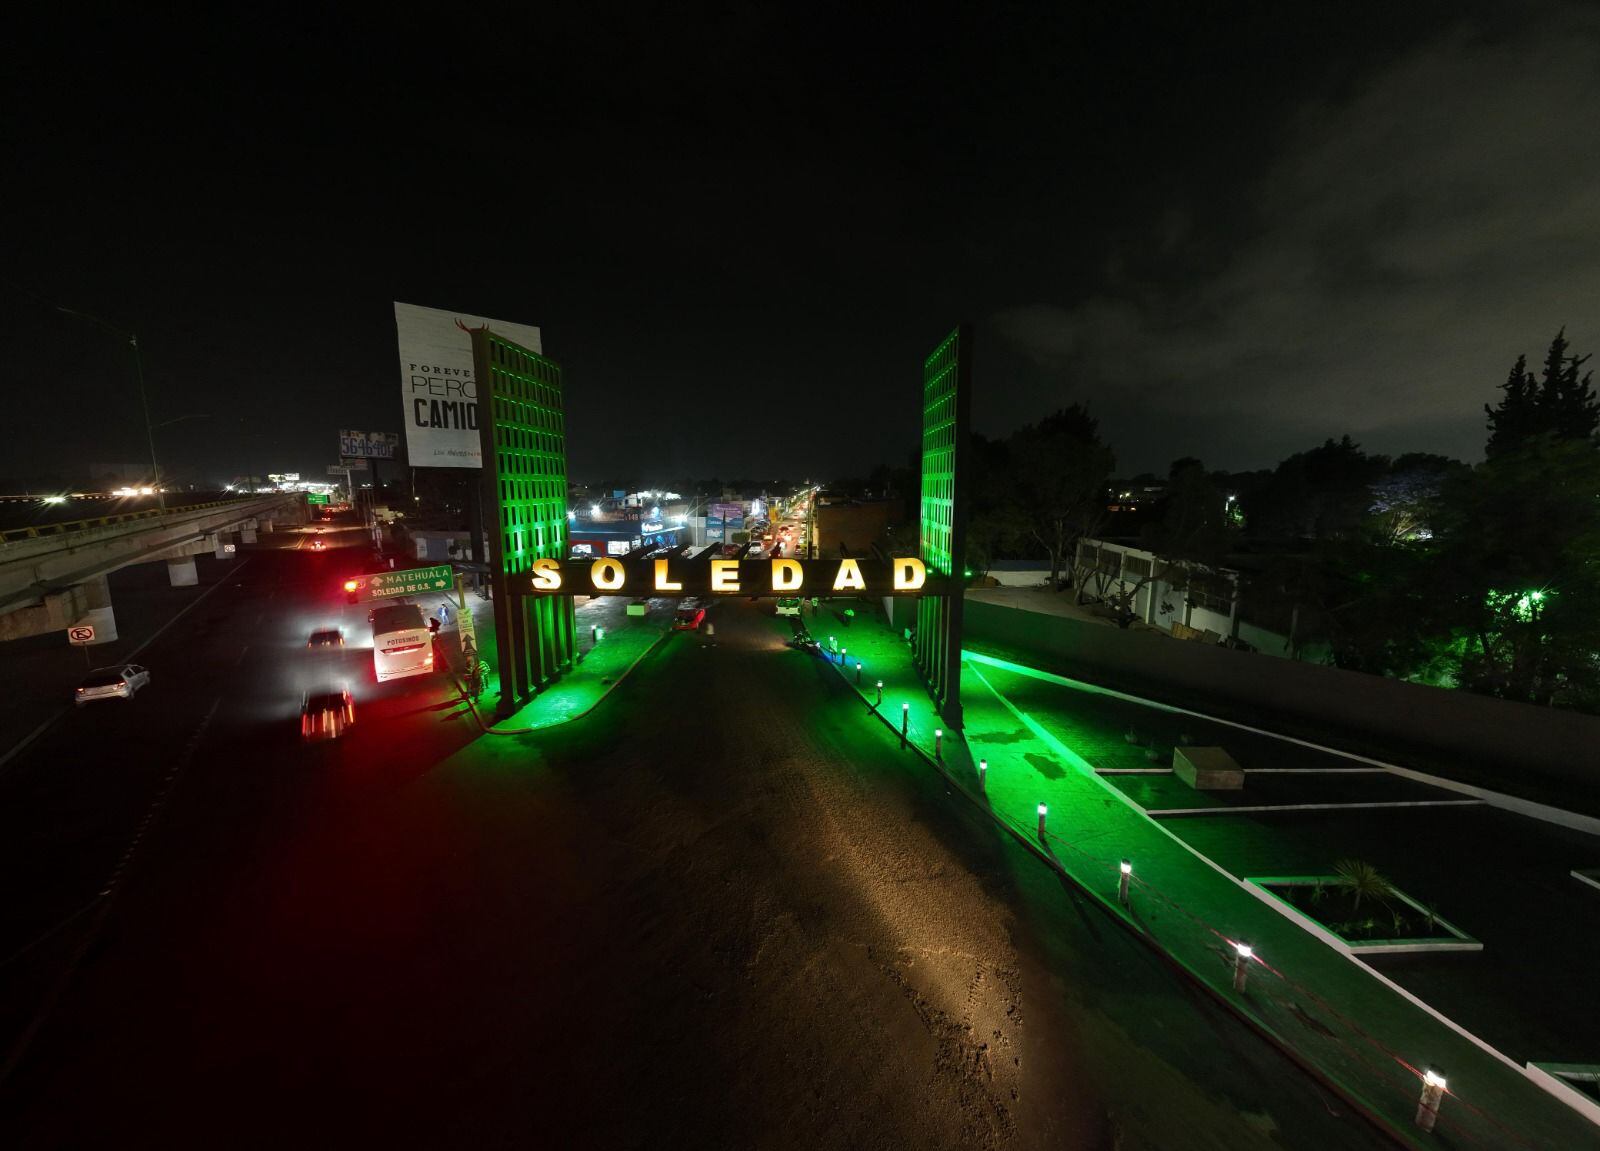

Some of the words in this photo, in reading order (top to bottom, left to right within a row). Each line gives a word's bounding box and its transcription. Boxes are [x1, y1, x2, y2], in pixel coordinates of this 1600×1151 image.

[386, 569, 449, 584] MATEHUALA
[531, 558, 927, 591] SOLEDAD
[372, 586, 404, 597] SOLEDAD
[407, 584, 416, 592] DE
